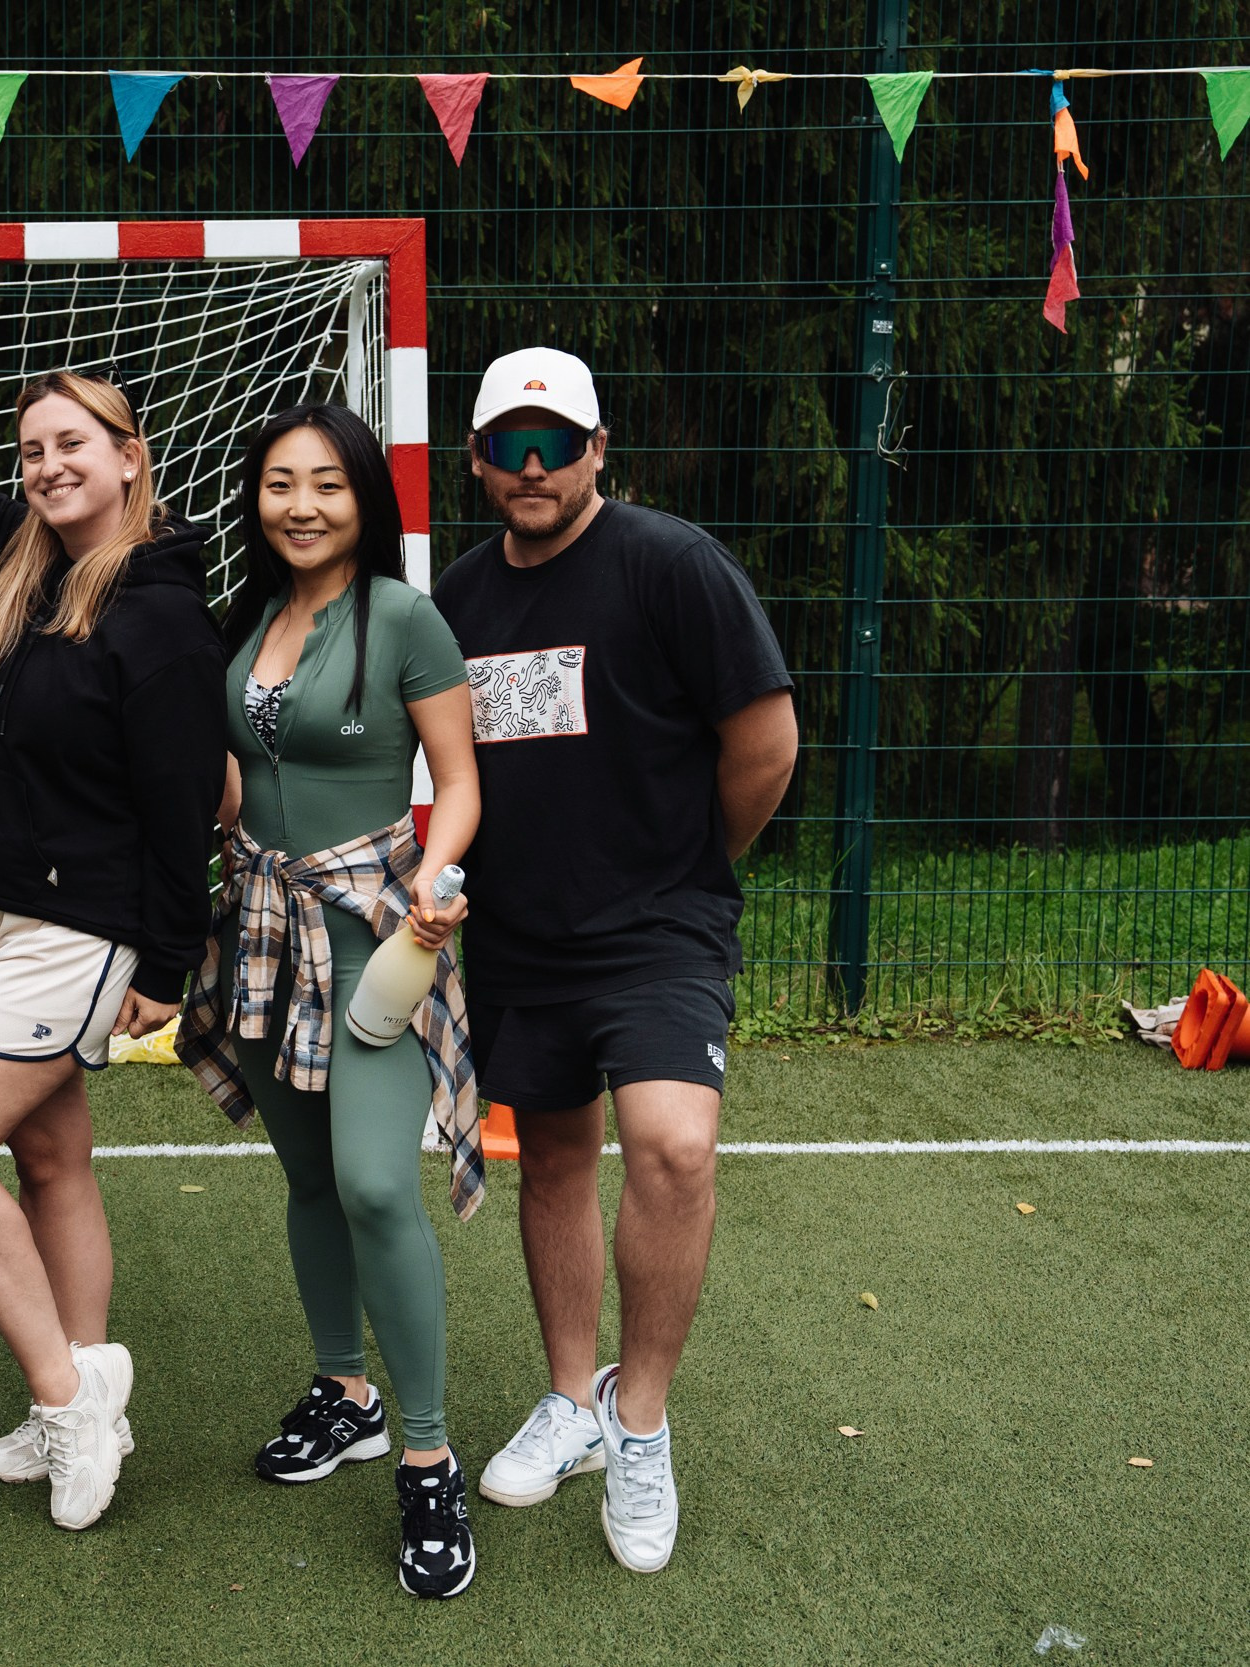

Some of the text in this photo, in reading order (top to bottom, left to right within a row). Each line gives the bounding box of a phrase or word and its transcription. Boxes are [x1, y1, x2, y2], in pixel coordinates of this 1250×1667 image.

[340, 719, 365, 735] alo
[31, 1023, 53, 1040] P
[330, 1417, 358, 1443] N
